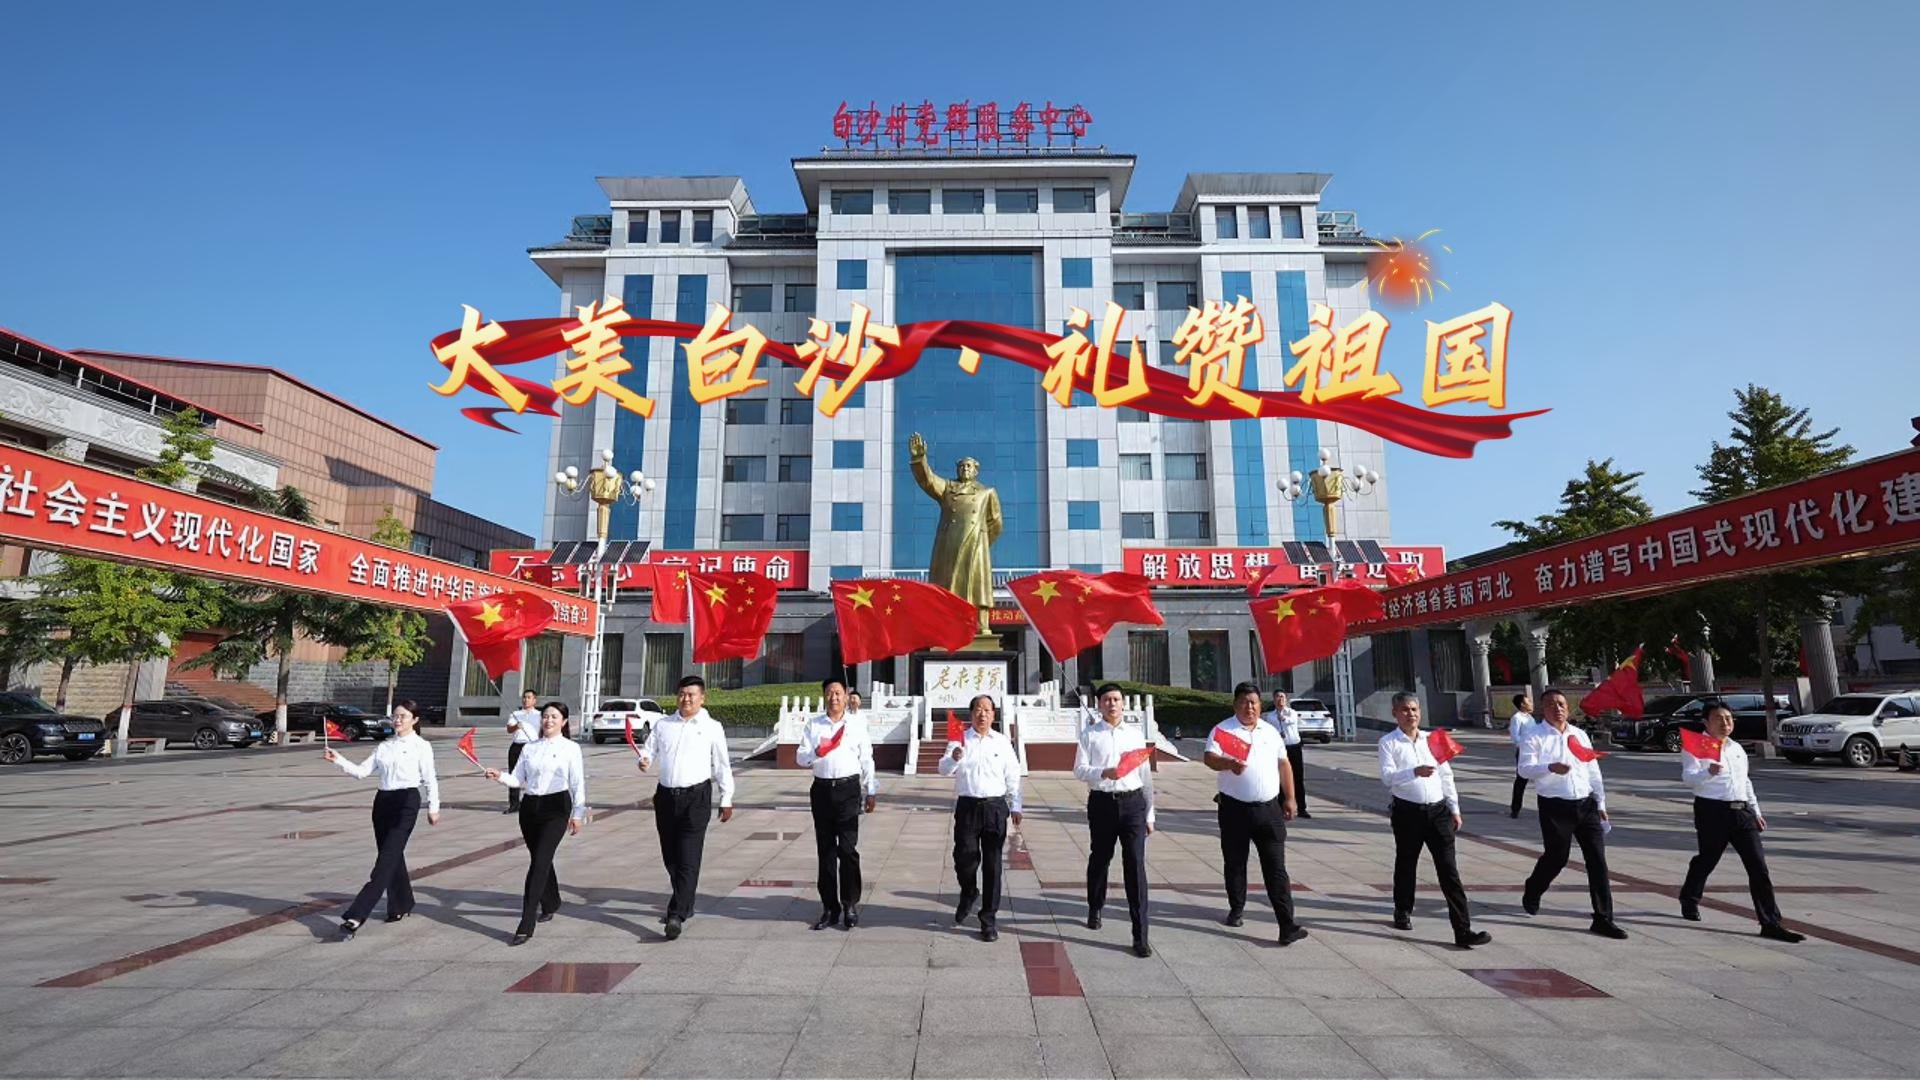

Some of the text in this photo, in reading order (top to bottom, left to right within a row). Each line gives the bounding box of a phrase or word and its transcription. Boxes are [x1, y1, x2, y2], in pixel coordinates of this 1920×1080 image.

[833, 99, 1093, 145] 白沙村党群服务中心
[0, 465, 321, 574] 社会主义现代化国家
[1535, 472, 1920, 593] 奋力谱写中国式现代化建
